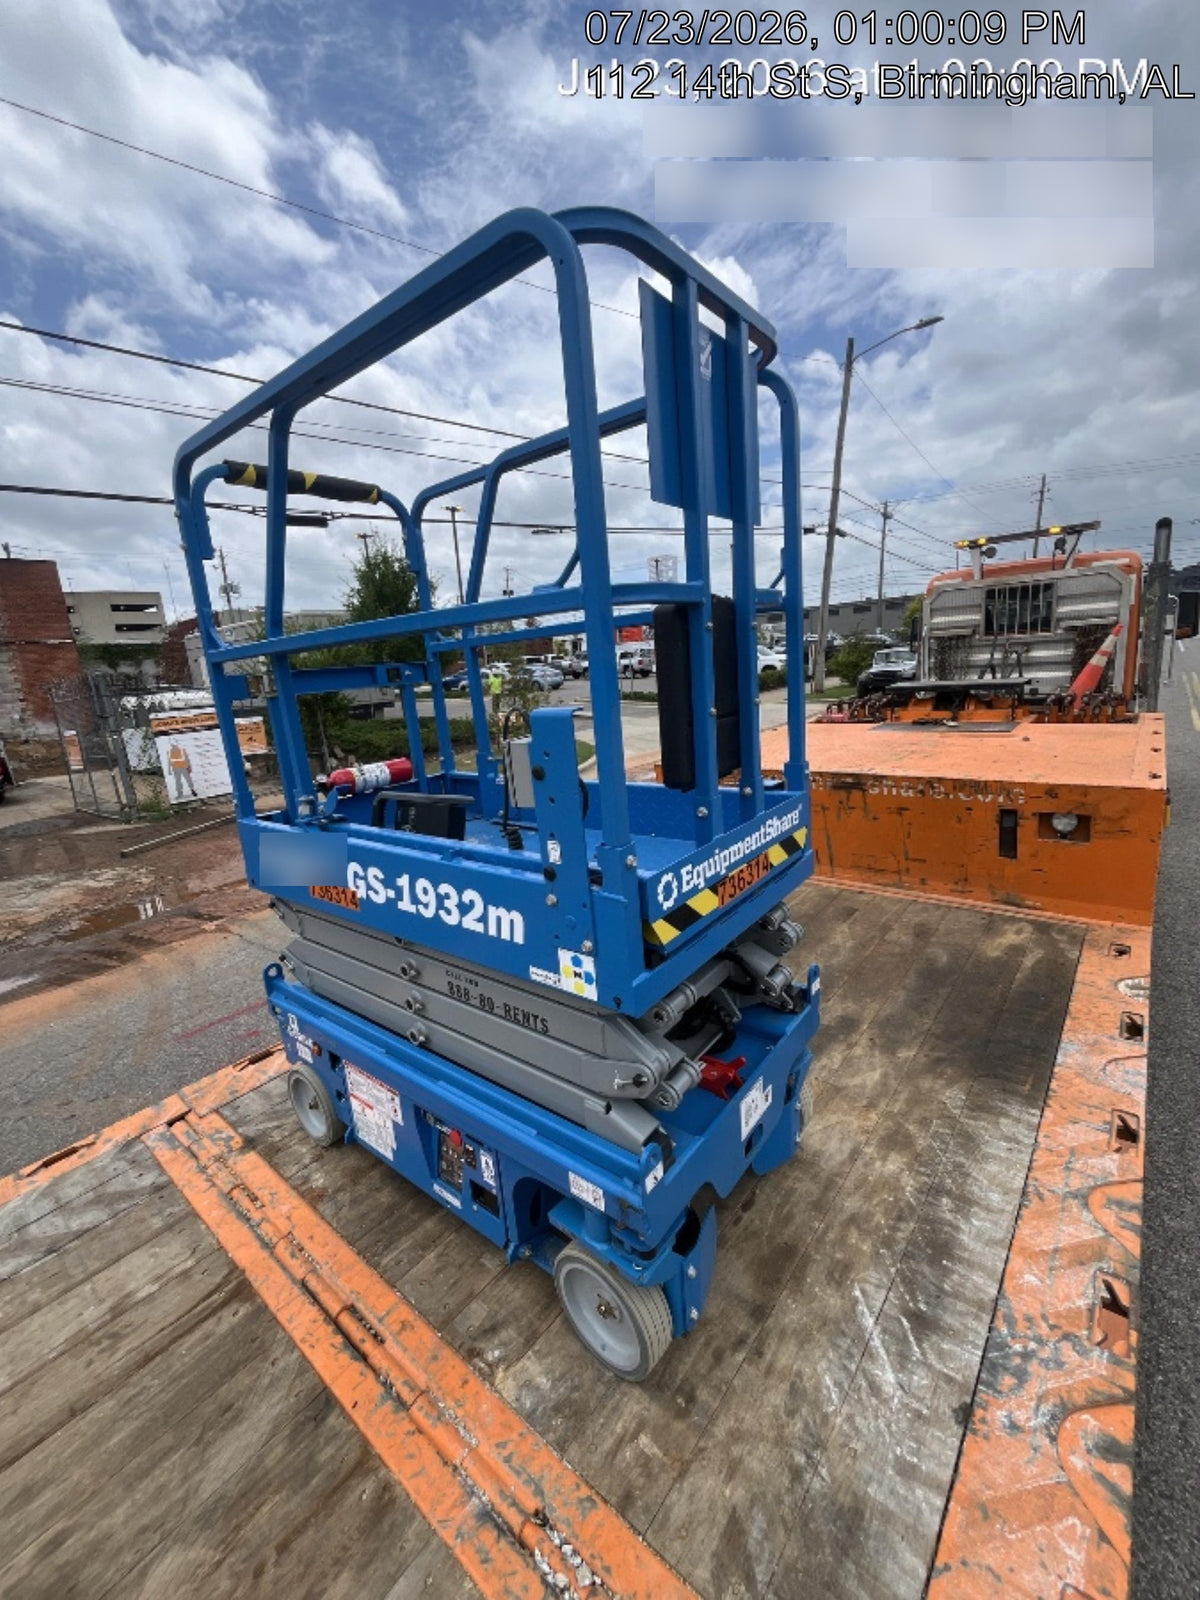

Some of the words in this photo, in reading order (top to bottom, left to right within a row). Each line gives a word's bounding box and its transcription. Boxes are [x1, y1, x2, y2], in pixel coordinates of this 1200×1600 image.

[680, 808, 800, 893] EquipmentShare
[718, 852, 771, 907] 736314
[346, 861, 525, 945] GS-1932m
